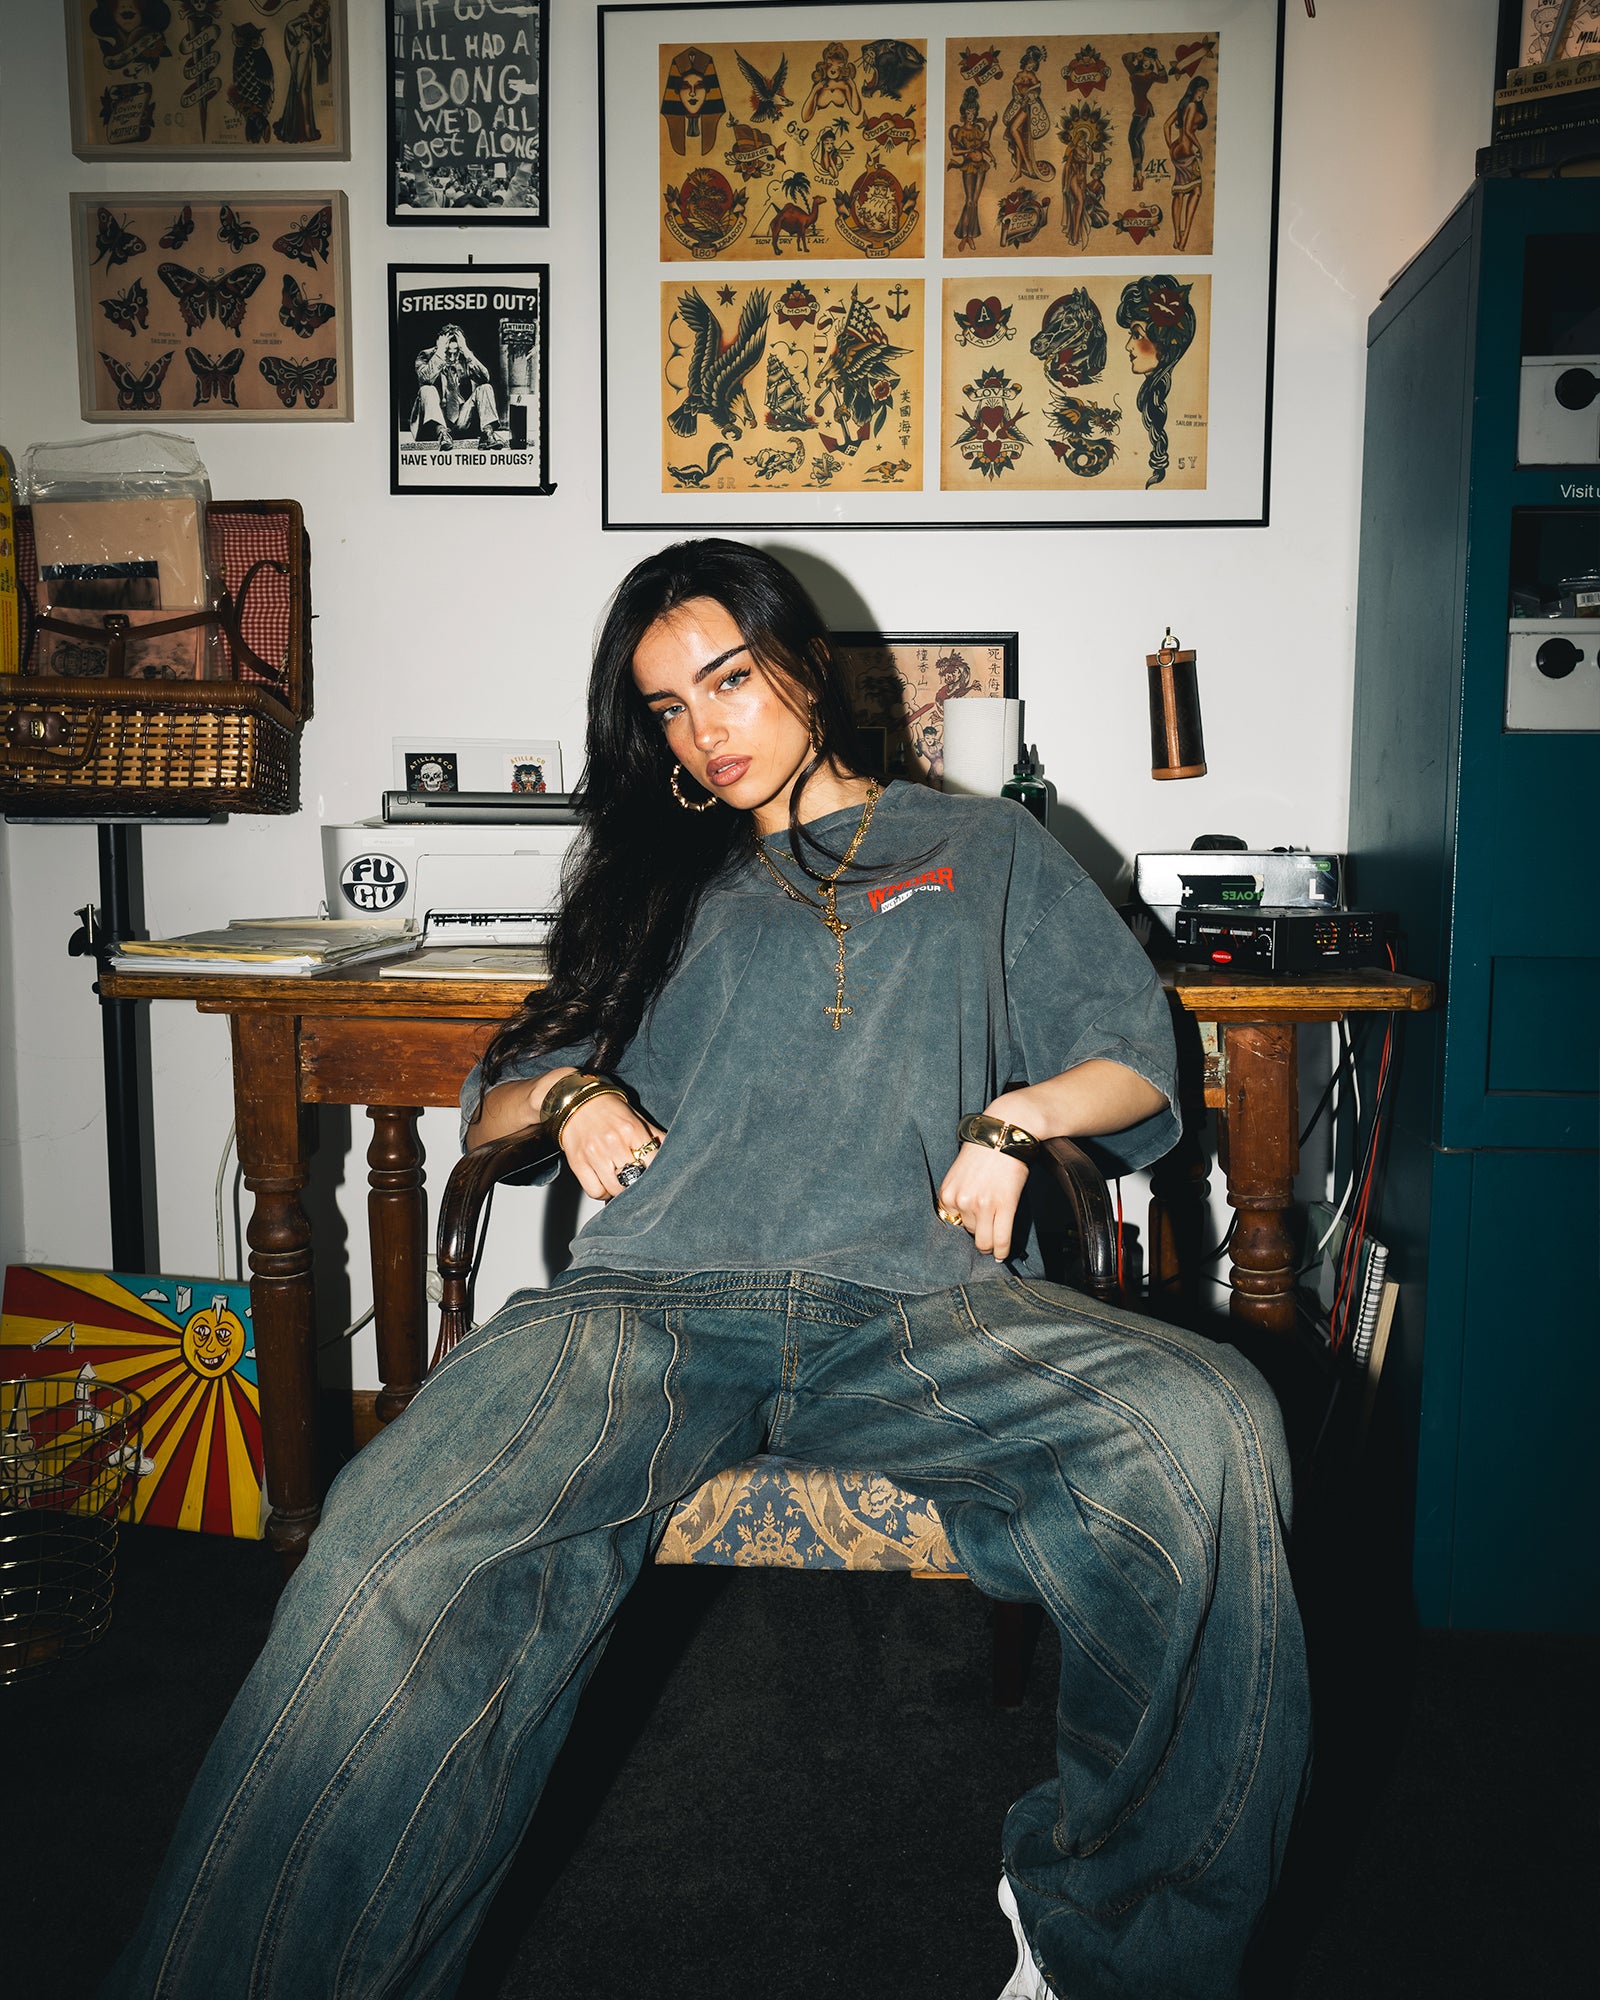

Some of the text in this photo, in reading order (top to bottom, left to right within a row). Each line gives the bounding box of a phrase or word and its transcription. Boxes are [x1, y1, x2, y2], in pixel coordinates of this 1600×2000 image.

[412, 29, 530, 60] ALL HAD A
[966, 60, 987, 78] MOM
[981, 67, 997, 82] DAD
[1073, 73, 1099, 82] MARY
[416, 65, 522, 111] BONG
[1499, 89, 1518, 98] STOP
[1519, 83, 1553, 95] LOOKING
[1555, 78, 1572, 88] AND
[414, 104, 537, 133] WE'D ALL
[865, 122, 889, 139] YOURS
[413, 129, 539, 168] get ALONG
[814, 175, 840, 187] CAIRO
[1011, 214, 1034, 223] GOOD
[717, 221, 744, 248] DRAGON
[888, 213, 916, 249] EQUATOR
[402, 294, 536, 313] STRESSED OUT?
[977, 306, 991, 322] A
[813, 299, 847, 354] USA
[966, 331, 1005, 346] NAME
[973, 388, 1012, 398] LOVE
[1003, 443, 1020, 451] DAD
[401, 454, 534, 466] HAVE YOU TRIED DRUGS?
[1560, 484, 1593, 498] Visit
[410, 756, 436, 771] ATILLA
[510, 755, 546, 765] ATILLA CO
[350, 858, 396, 883] FU
[353, 884, 397, 909] GU
[914, 884, 942, 894] TOUR
[1309, 878, 1325, 899] L
